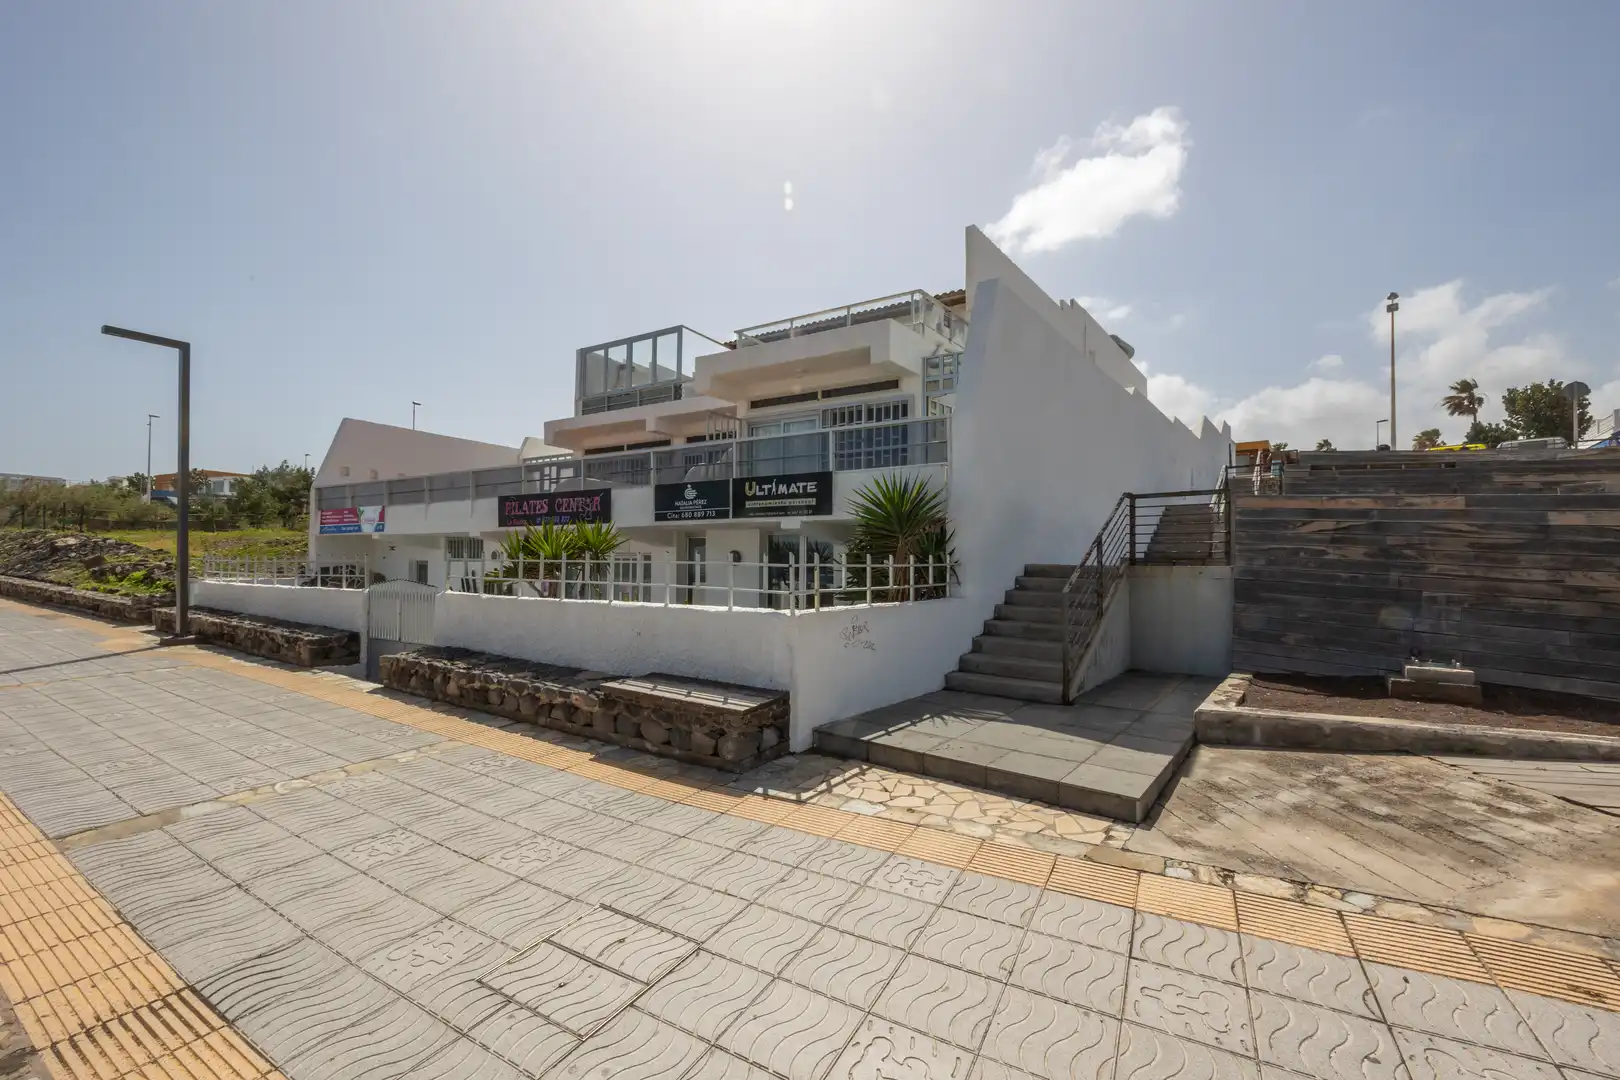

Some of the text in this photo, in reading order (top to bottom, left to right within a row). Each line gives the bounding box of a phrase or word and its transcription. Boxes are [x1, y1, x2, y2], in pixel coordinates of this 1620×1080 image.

[745, 479, 818, 496] ULTIMATE
[505, 499, 549, 515] PILATES
[694, 510, 705, 518] 889
